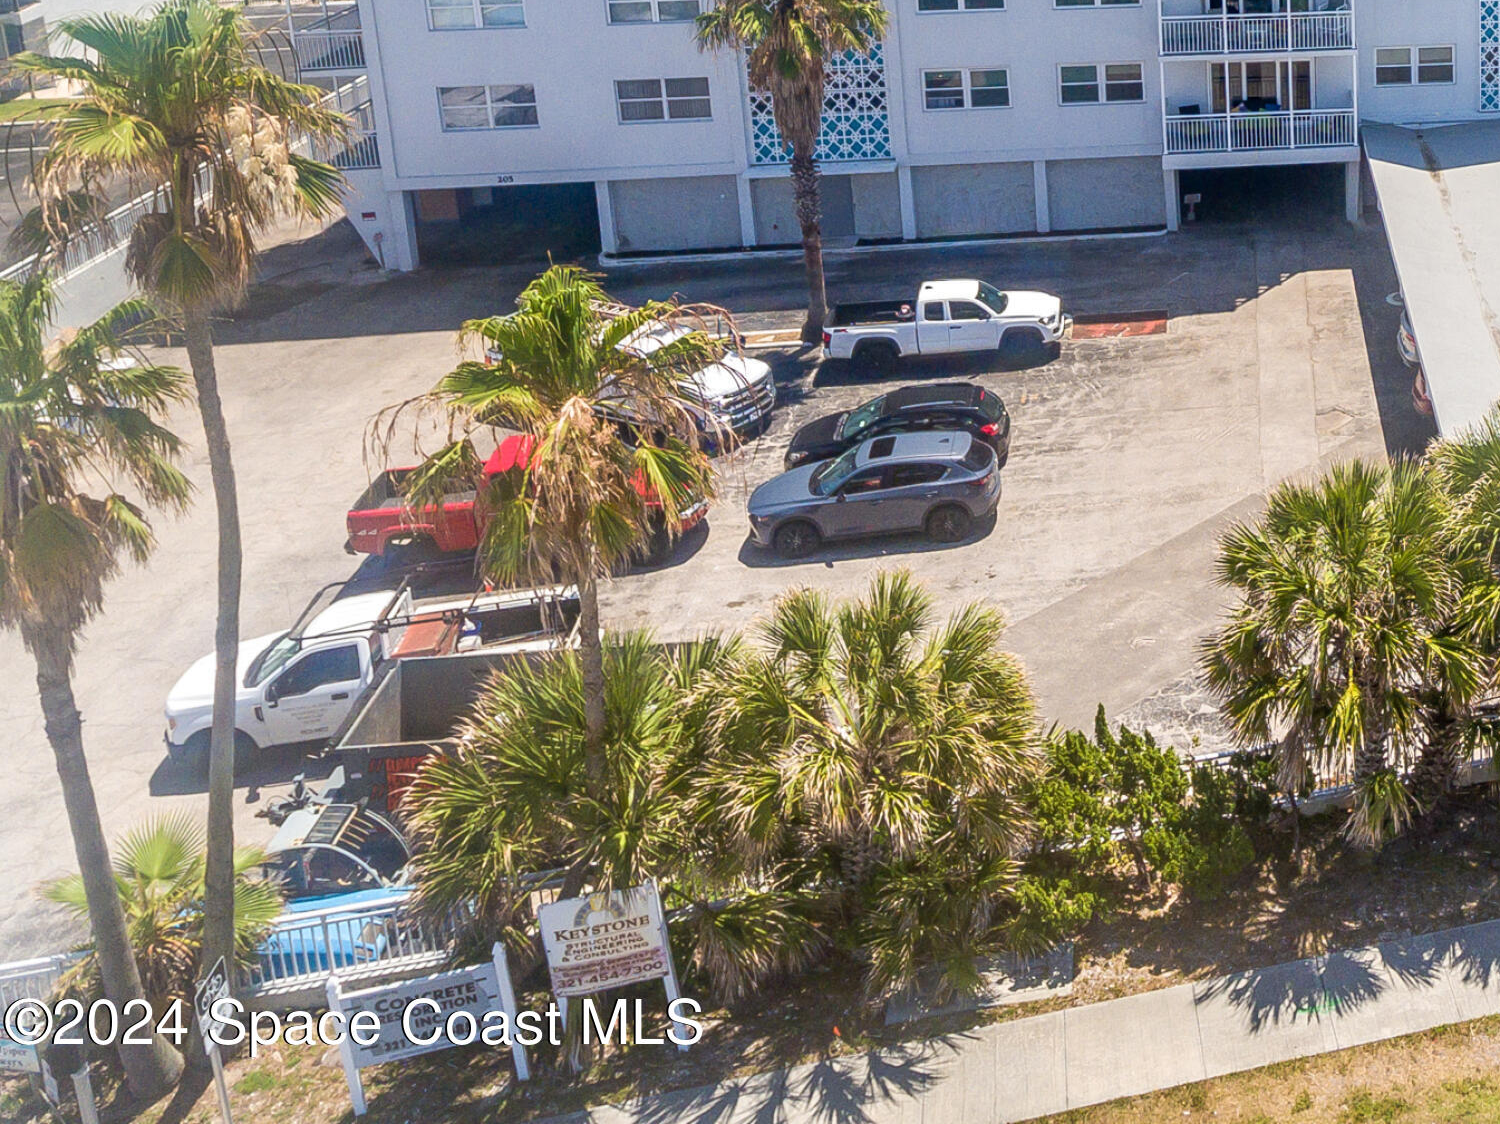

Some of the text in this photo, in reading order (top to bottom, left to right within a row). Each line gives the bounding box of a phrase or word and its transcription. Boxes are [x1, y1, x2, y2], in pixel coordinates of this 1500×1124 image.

[554, 915, 650, 947] KEYSTONE
[566, 931, 640, 950] STRUCTURAL
[561, 955, 570, 963] &
[574, 941, 649, 961] CONSULTING
[564, 937, 644, 956] ENGINEERING
[557, 961, 663, 988] 321-454-7300
